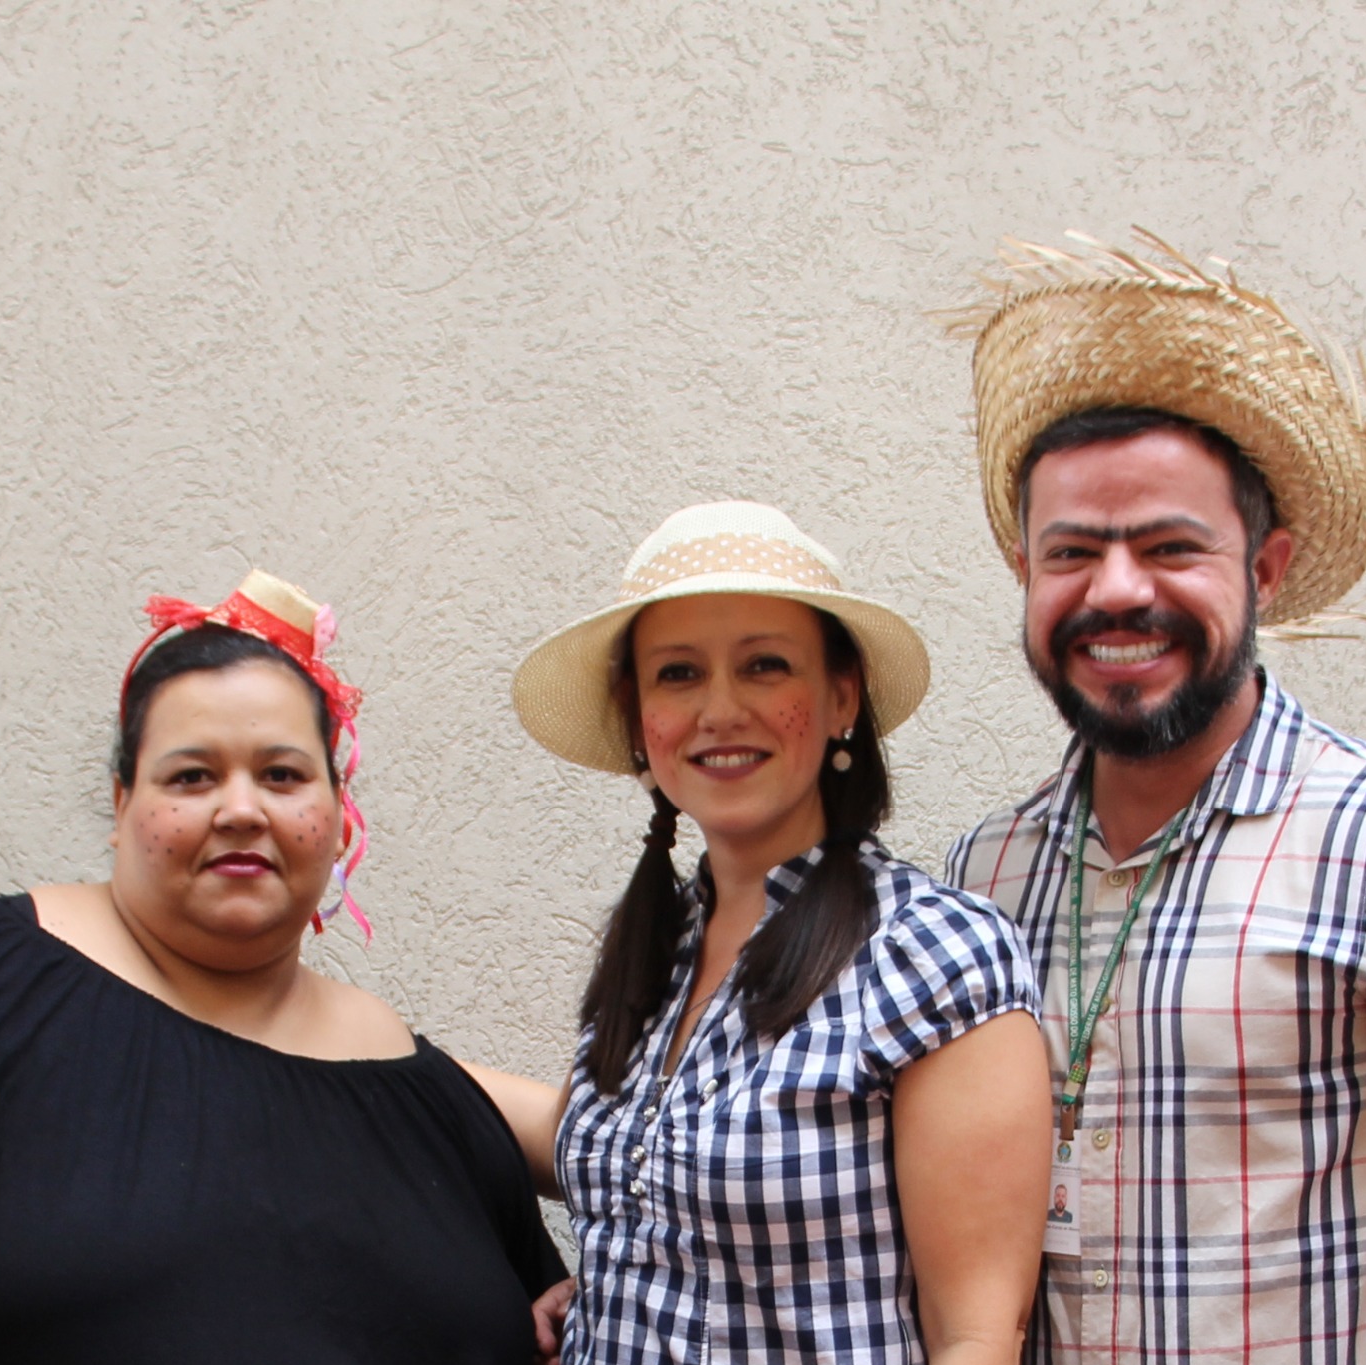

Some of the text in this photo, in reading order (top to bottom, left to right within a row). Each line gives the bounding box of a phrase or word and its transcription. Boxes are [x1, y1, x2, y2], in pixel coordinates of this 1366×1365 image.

[1070, 967, 1077, 976] DE
[1093, 980, 1105, 1002] MATO
[1090, 1002, 1099, 1013] DE
[1070, 1026, 1077, 1036] DO
[1080, 1013, 1095, 1043] FEDERAL
